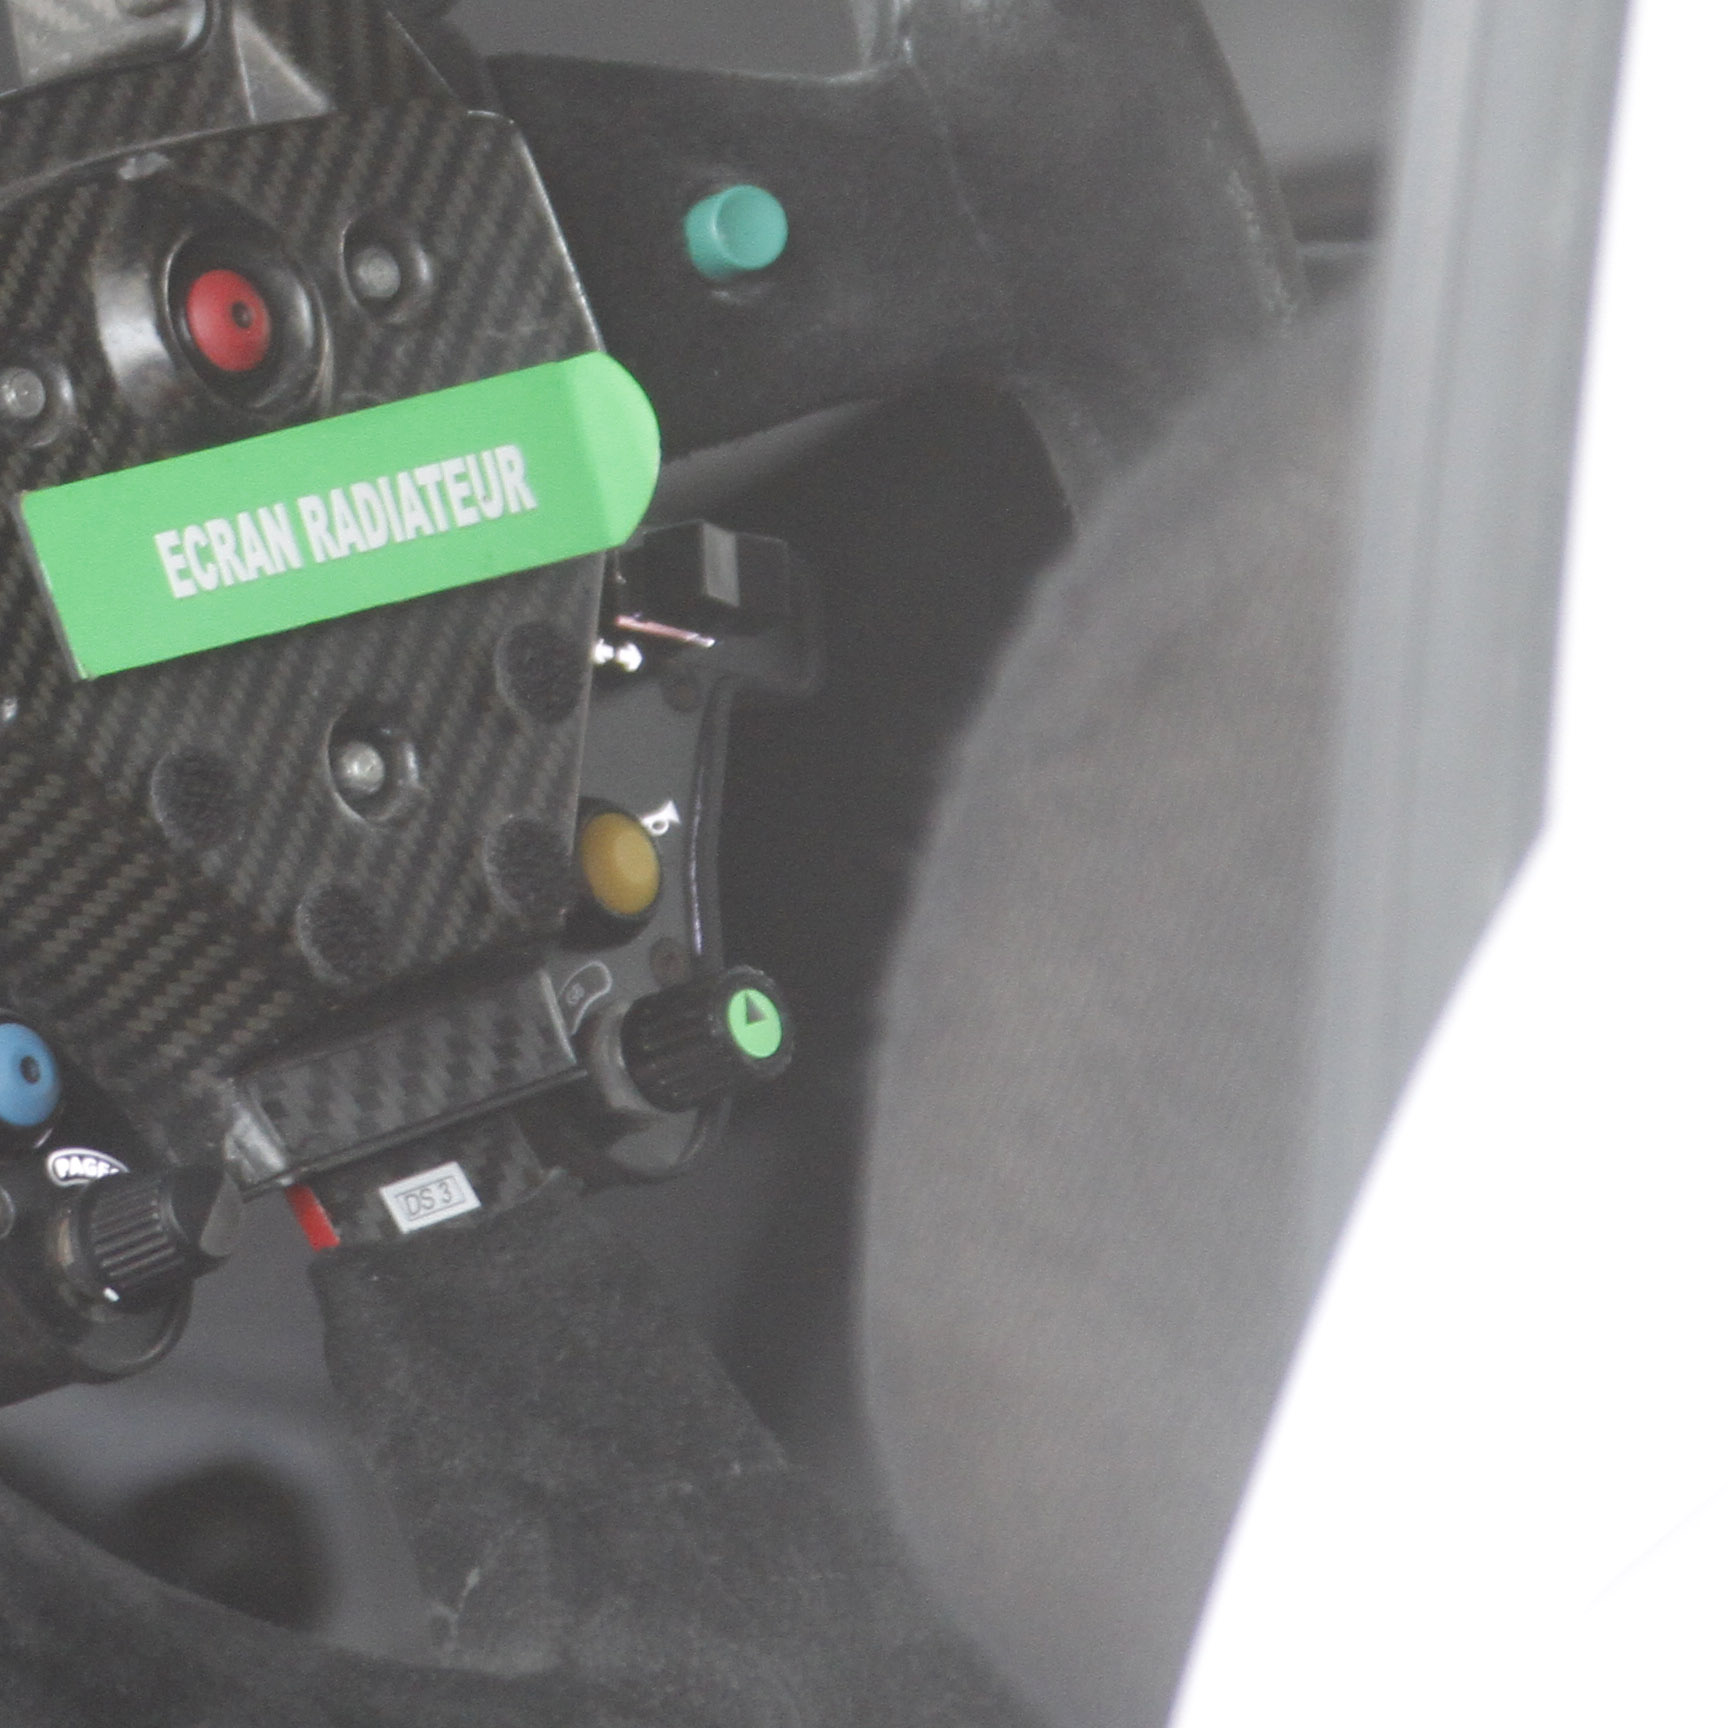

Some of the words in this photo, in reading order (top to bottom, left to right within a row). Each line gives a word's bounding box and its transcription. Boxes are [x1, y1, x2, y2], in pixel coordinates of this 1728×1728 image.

[153, 502, 305, 599] ECRAN
[297, 444, 539, 564] RADIATEUR
[405, 1187, 435, 1215] DS
[438, 1181, 452, 1204] 3
